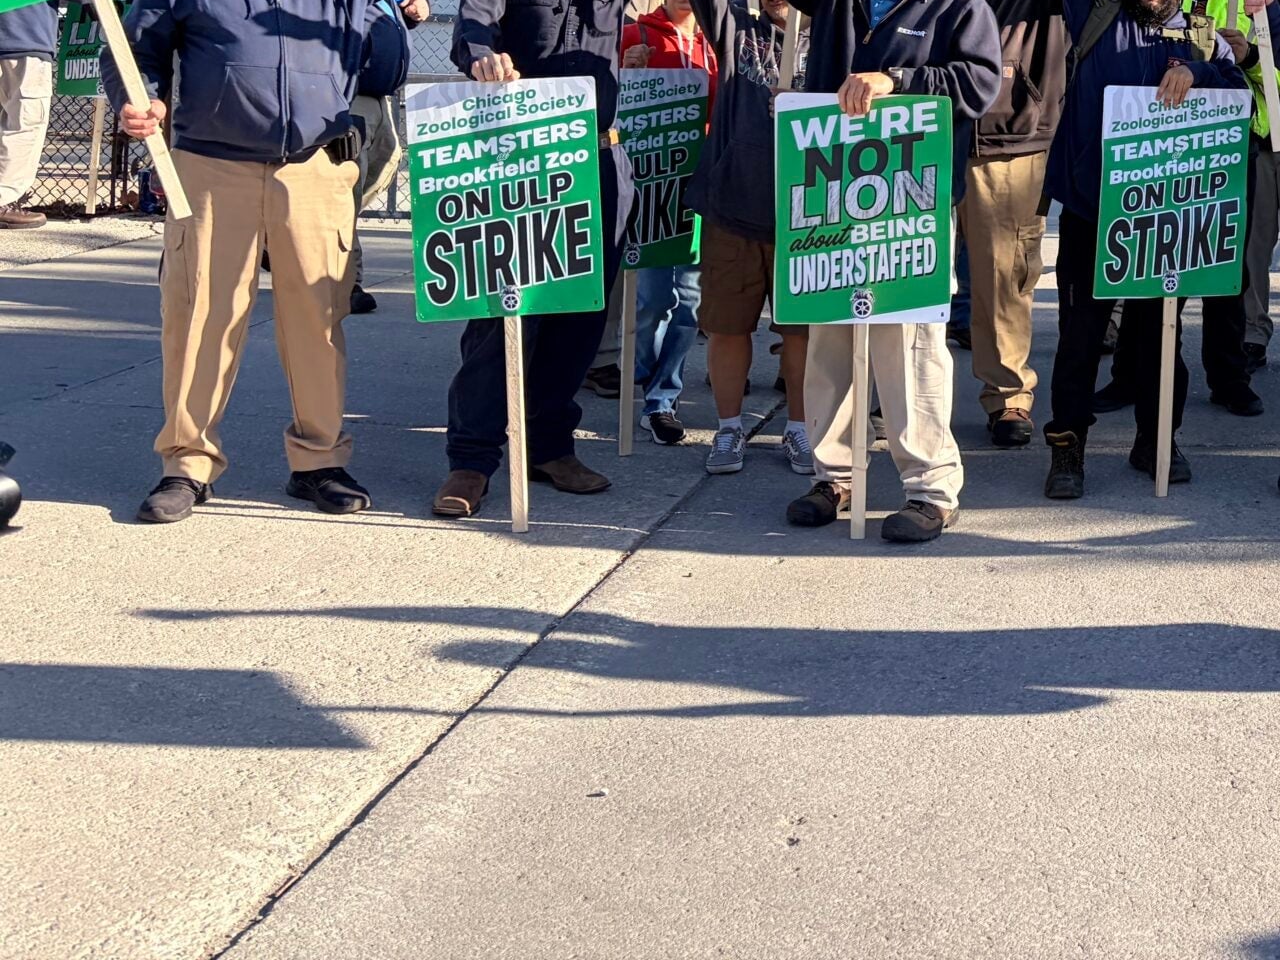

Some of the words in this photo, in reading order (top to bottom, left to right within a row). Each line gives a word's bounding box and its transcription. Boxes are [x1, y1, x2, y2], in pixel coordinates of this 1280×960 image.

[462, 87, 536, 113] Chicago
[618, 76, 664, 92] hicago
[649, 82, 701, 100] Society
[416, 109, 512, 137] Zoological
[516, 92, 586, 120] Society
[617, 104, 700, 133] MSTERS
[790, 101, 938, 151] WE'RE
[1112, 111, 1187, 133] Zoological
[1191, 103, 1244, 121] Society
[417, 118, 588, 170] TEAMSTERS
[624, 134, 664, 154] field
[667, 128, 700, 142] Zoo
[804, 131, 925, 188] NOT
[1111, 125, 1243, 162] TEAMSTERS
[419, 154, 540, 195] Brookfield
[545, 148, 589, 170] Zoo
[632, 146, 689, 181] ULP
[1110, 155, 1206, 185] Brookfield
[1209, 152, 1242, 169] Zoo
[436, 186, 493, 225] ON
[500, 170, 574, 214] ULP
[626, 172, 695, 247] RIKE
[789, 164, 938, 231] LION
[1121, 180, 1166, 213] ON
[1171, 170, 1228, 204] ULP
[423, 200, 593, 306] STRIKE
[789, 223, 854, 253] about
[850, 214, 936, 244] BEING
[1103, 197, 1241, 285] STRIKE
[789, 236, 937, 296] UNDERSTAFFED
